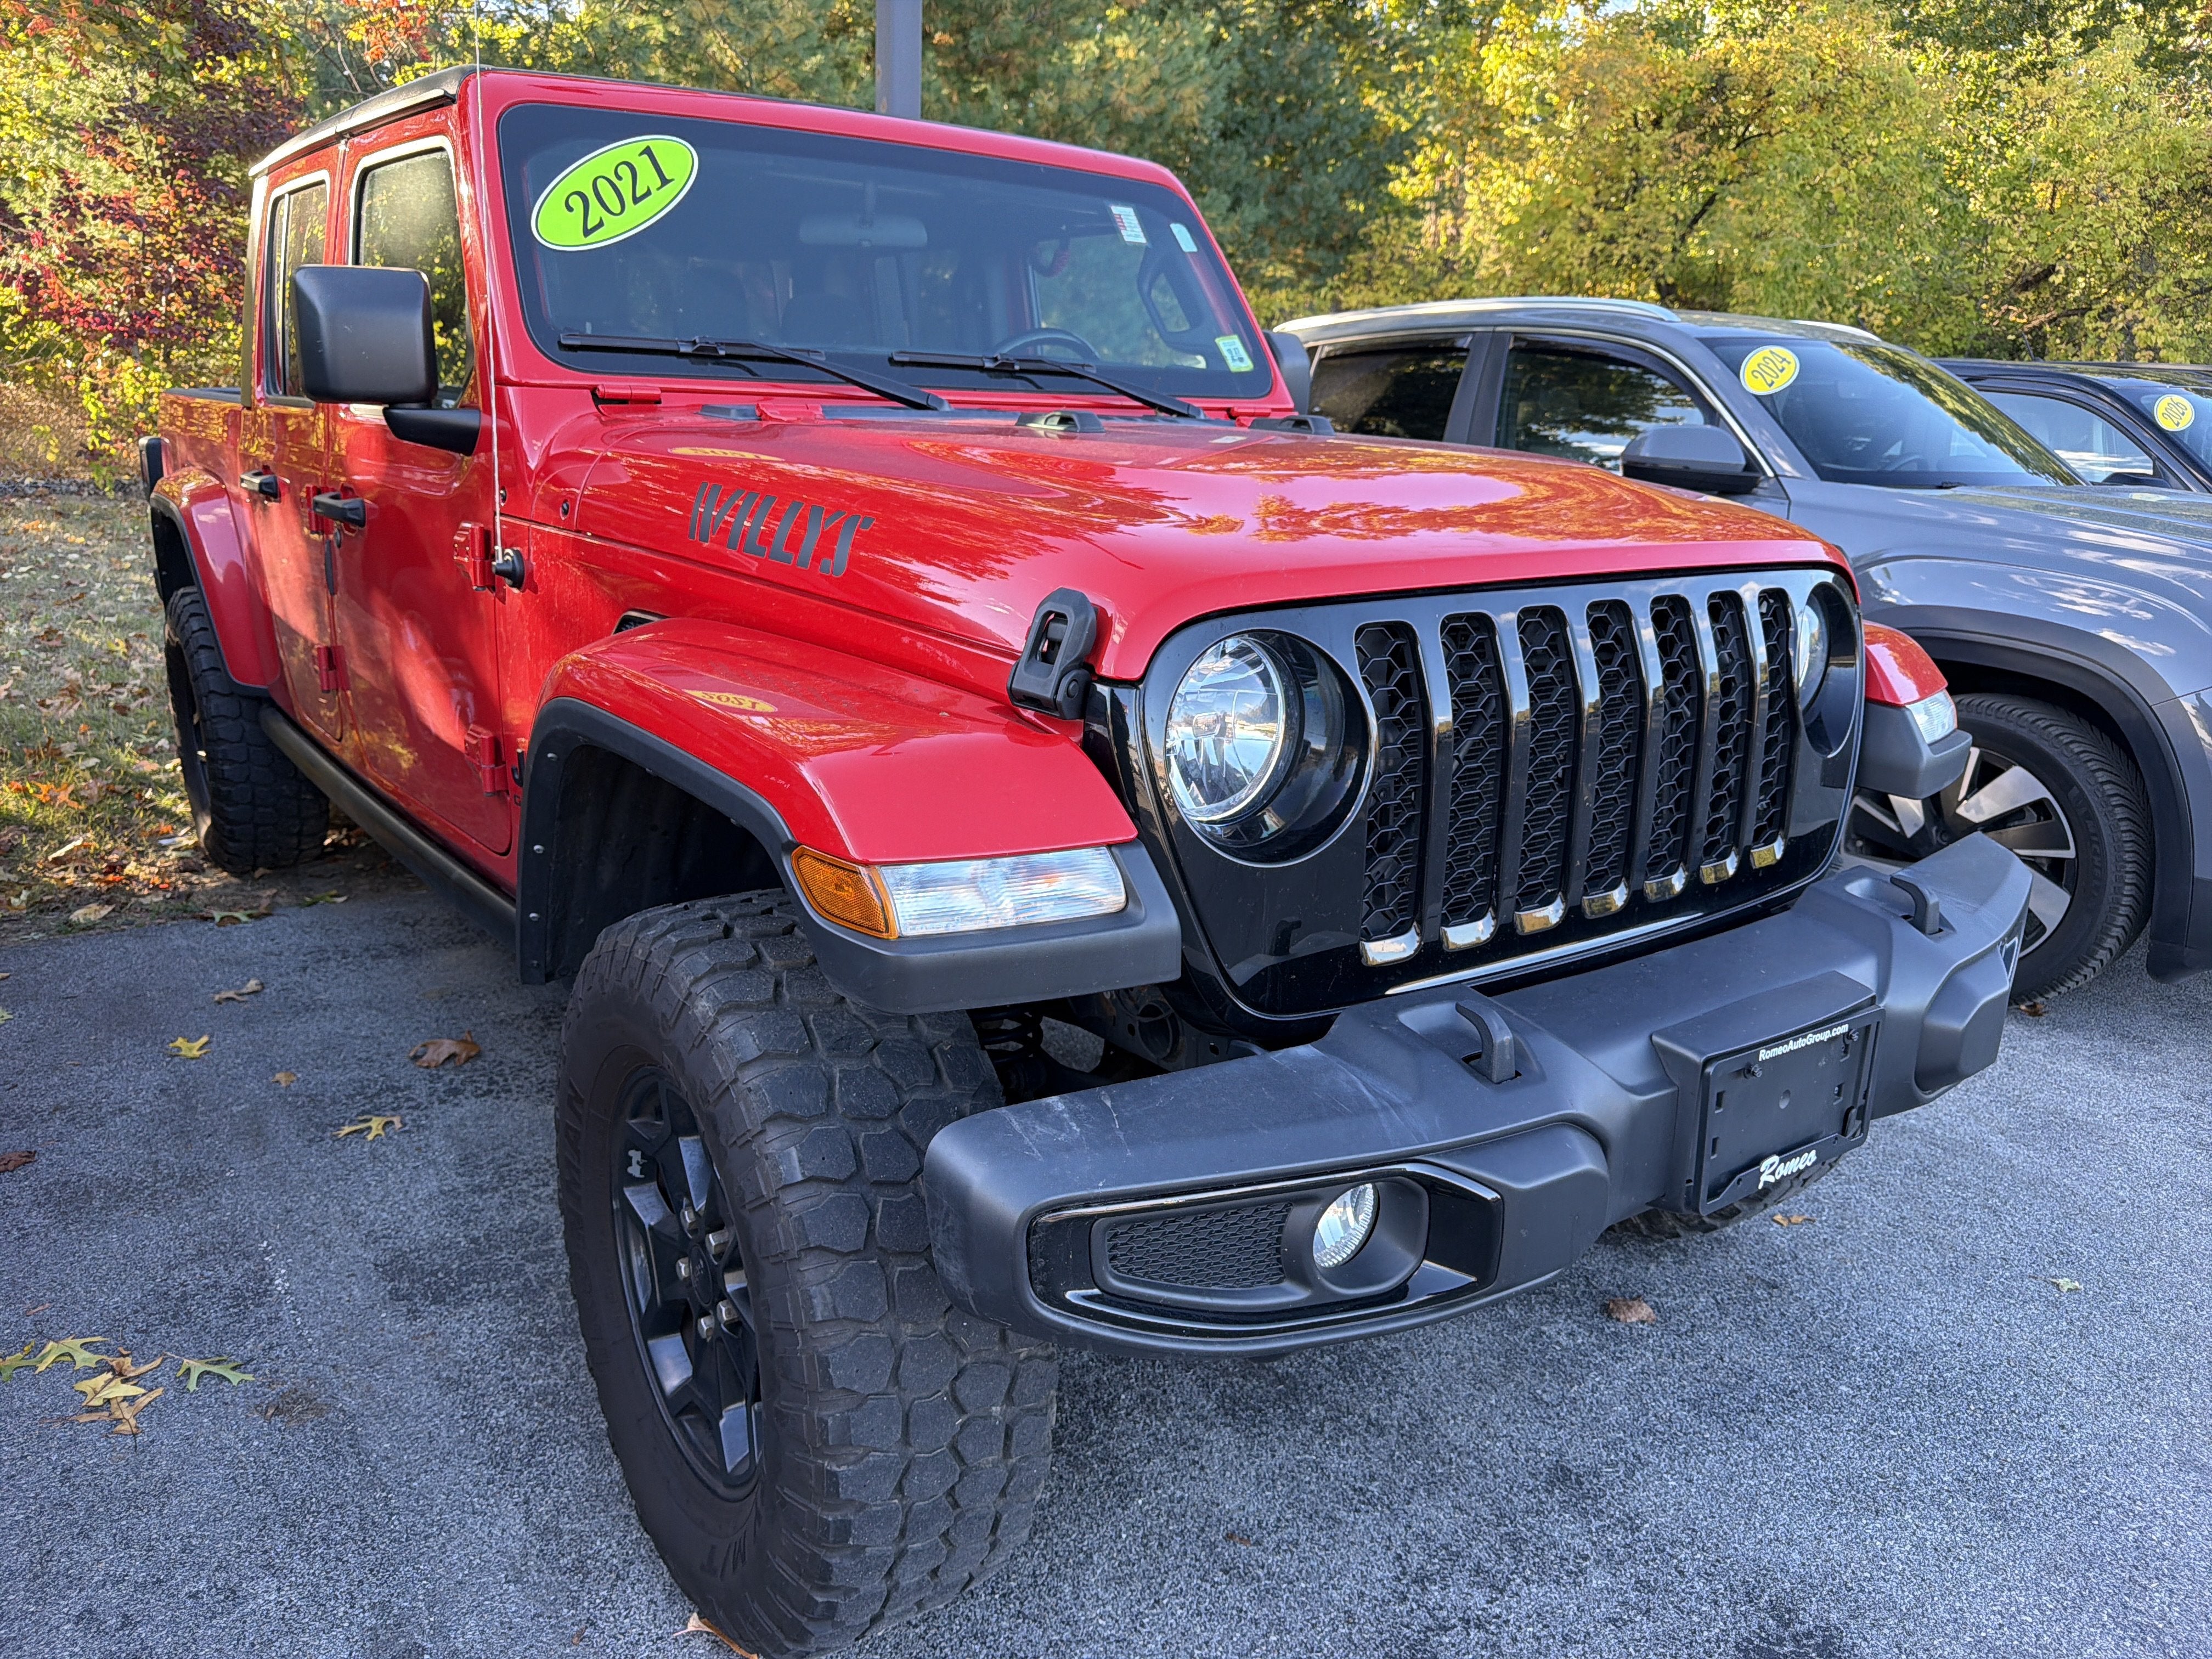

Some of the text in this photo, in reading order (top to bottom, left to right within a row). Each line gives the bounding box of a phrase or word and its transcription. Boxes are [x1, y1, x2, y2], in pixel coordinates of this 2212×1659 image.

[565, 145, 675, 239] 2021
[1751, 349, 1792, 387] 2024
[2162, 397, 2188, 427] 2026
[688, 481, 876, 577] WILLYS
[1758, 1024, 1849, 1062] RomeoAutoGroup.com
[1758, 1149, 1818, 1189] Romeo
